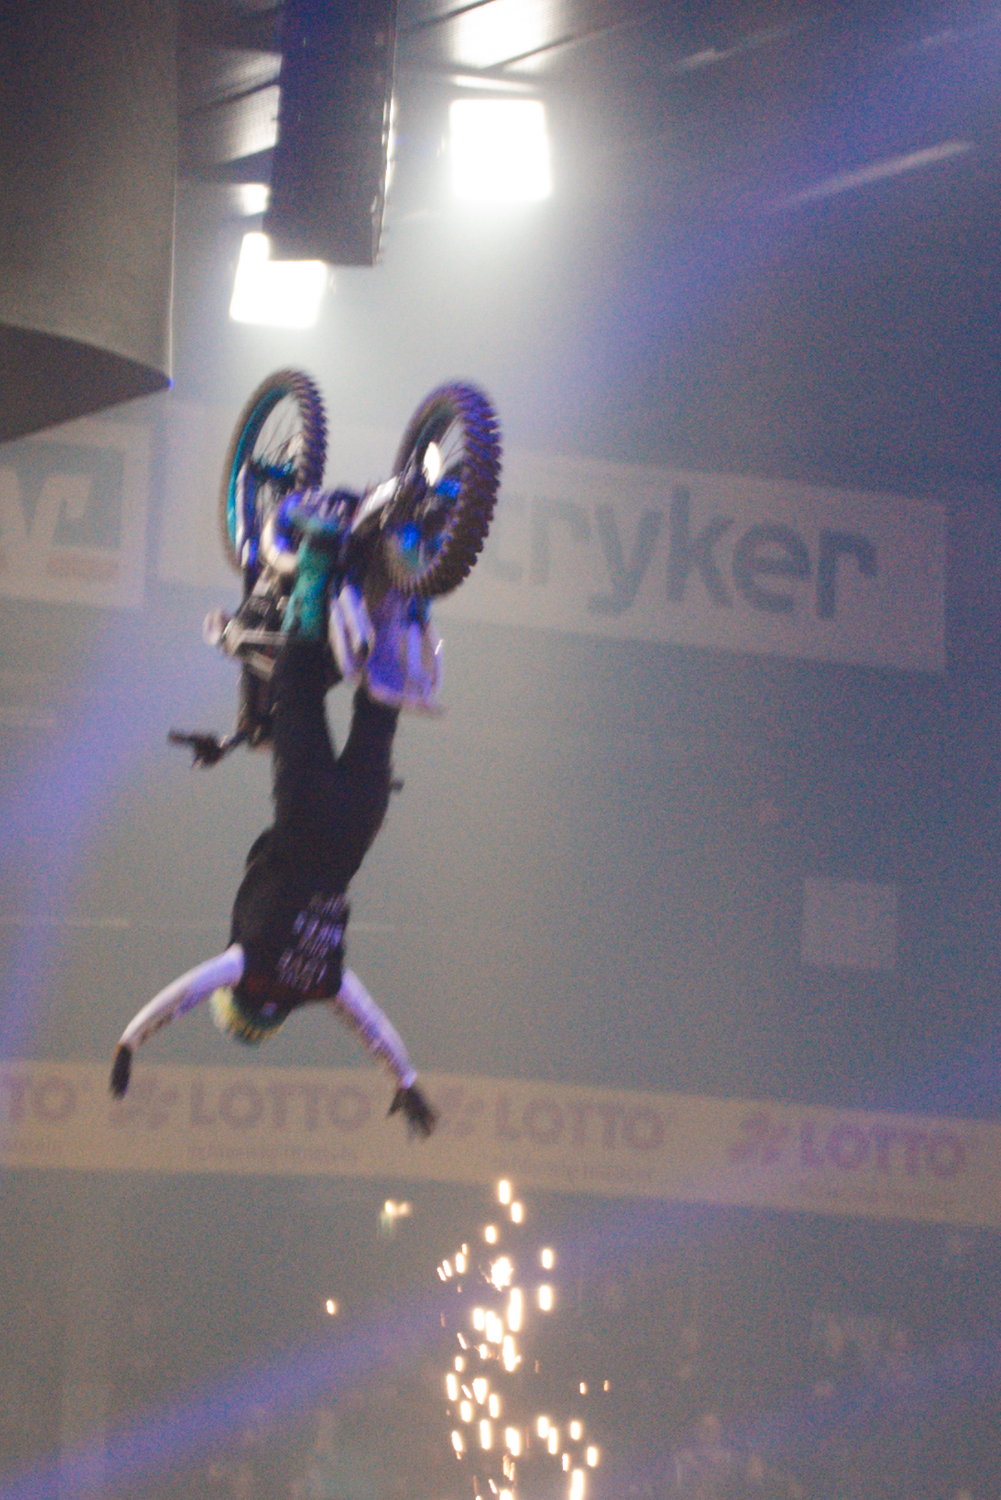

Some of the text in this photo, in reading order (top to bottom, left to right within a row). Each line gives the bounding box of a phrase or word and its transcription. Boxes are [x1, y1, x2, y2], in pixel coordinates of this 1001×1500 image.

[190, 1080, 370, 1131] LOTTO
[494, 1093, 665, 1151] LOTTO
[800, 1120, 967, 1180] LOTTO
